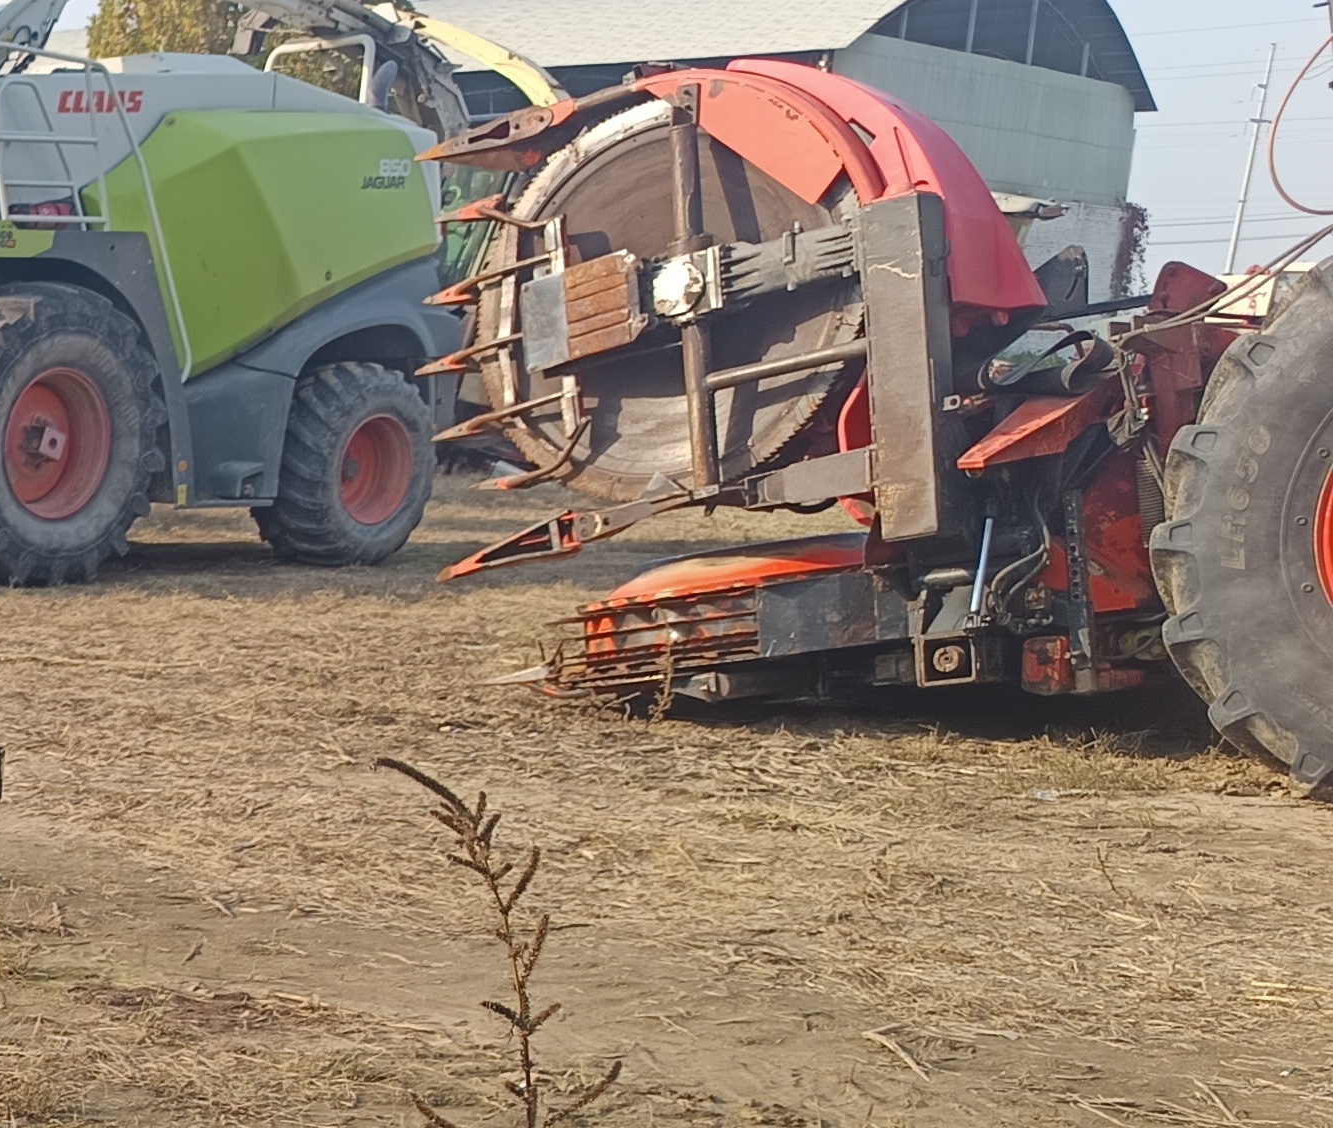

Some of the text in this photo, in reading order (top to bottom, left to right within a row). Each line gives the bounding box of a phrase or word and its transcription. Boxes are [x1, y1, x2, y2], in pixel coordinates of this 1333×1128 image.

[57, 90, 143, 113] CLAAS
[378, 159, 411, 176] 850
[361, 176, 405, 189] JAGUAR
